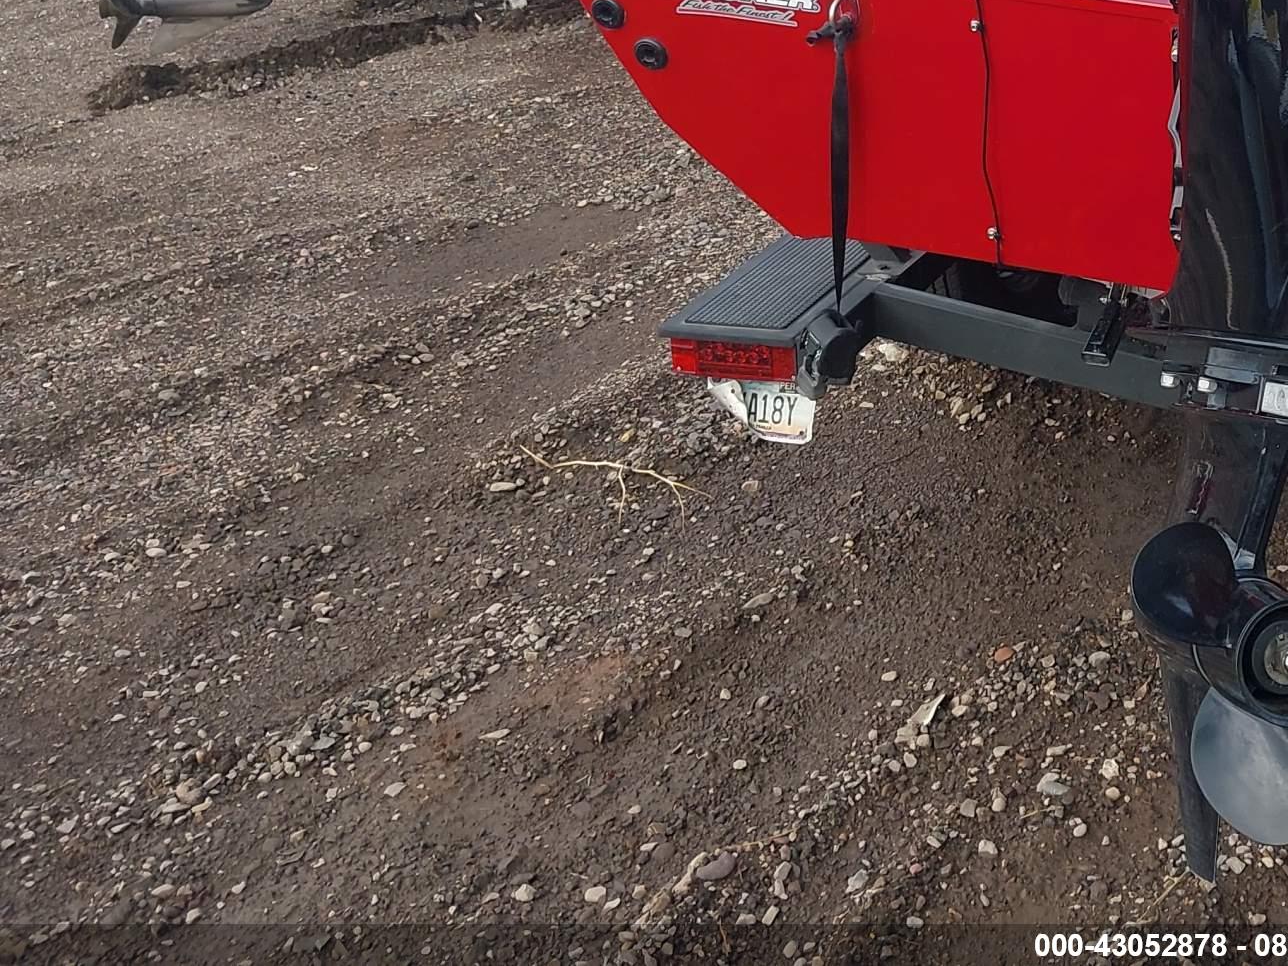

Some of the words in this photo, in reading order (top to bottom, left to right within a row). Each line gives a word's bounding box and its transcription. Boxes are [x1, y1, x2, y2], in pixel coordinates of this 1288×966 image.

[682, 0, 713, 9] Fish
[713, 4, 736, 13] the
[743, 393, 797, 426] A18Y
